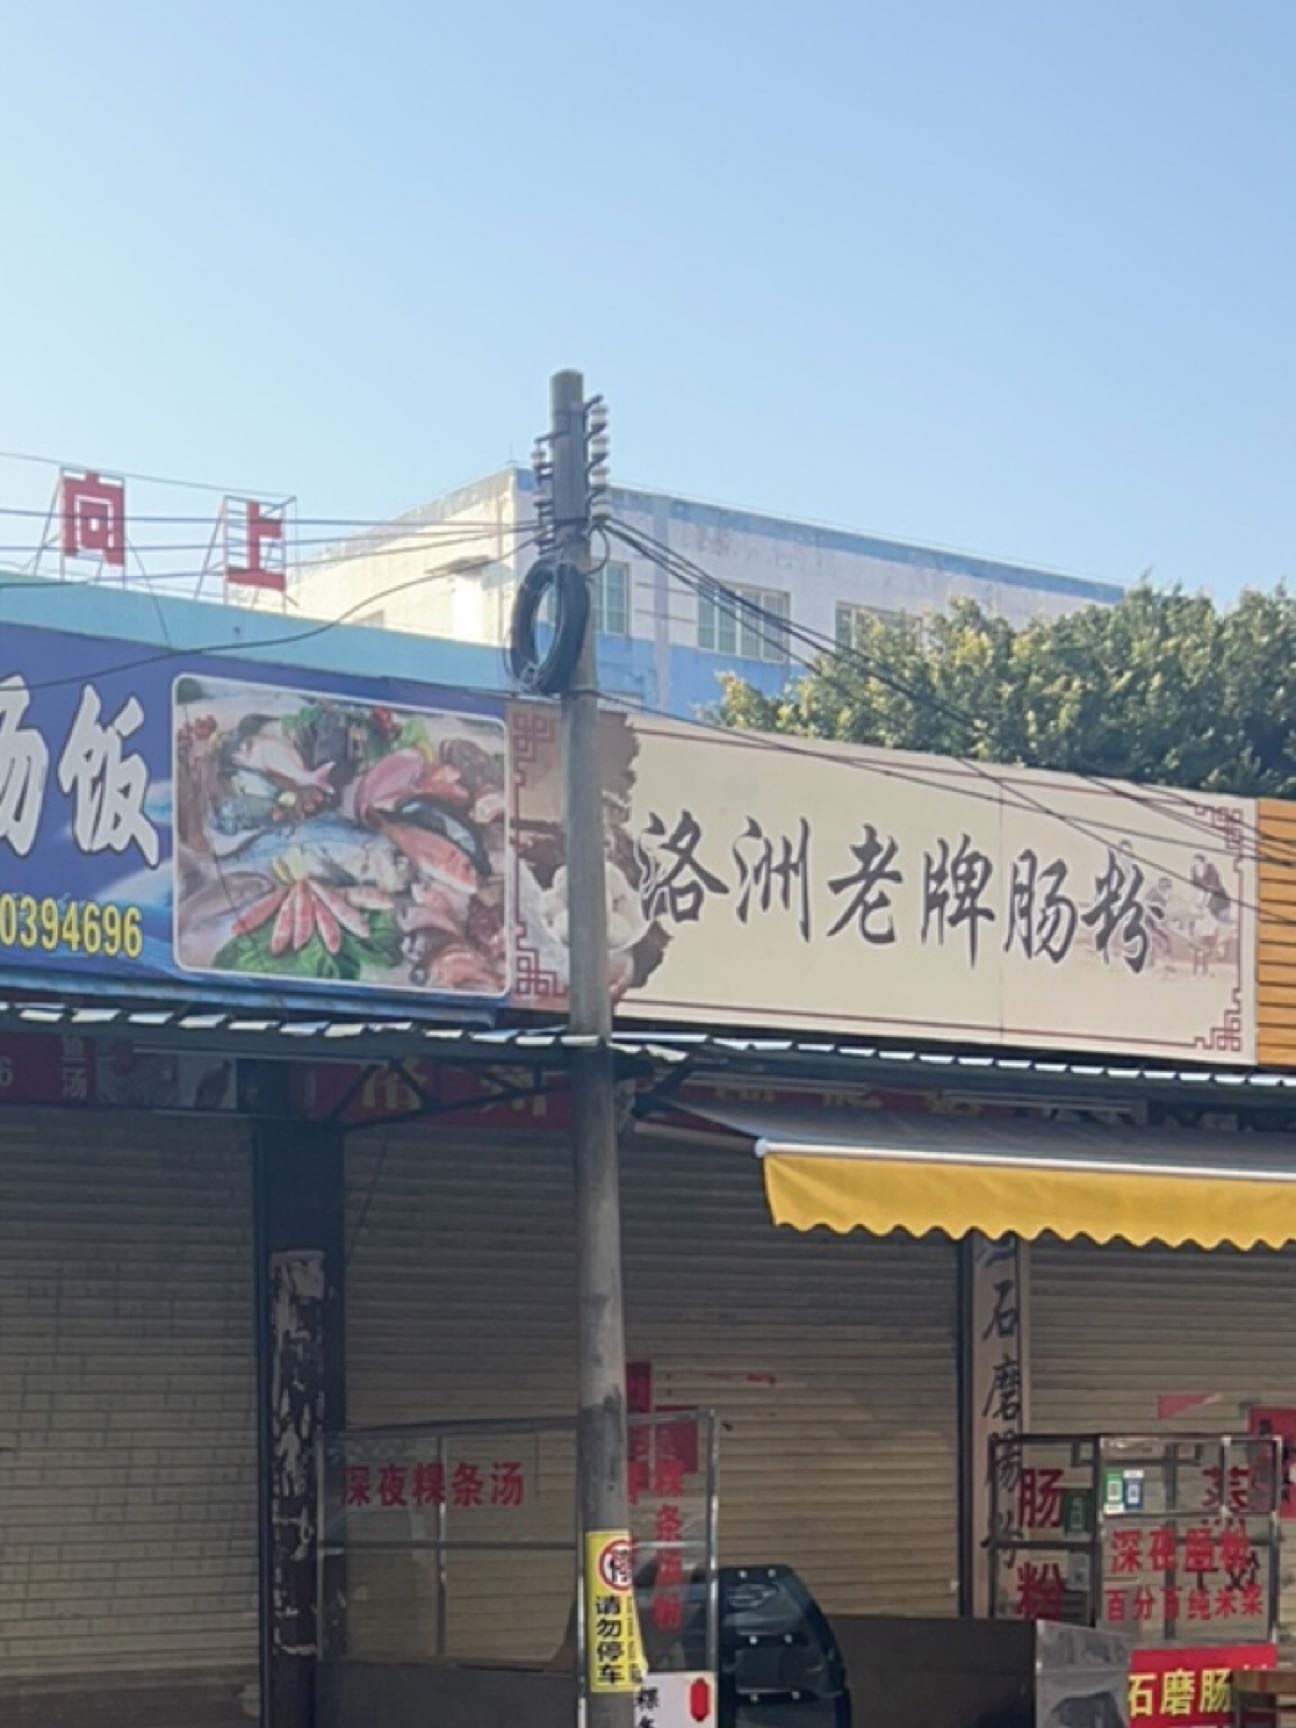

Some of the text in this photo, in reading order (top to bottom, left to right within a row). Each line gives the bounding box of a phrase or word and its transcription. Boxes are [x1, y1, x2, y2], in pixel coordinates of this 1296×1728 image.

[595, 1596, 625, 1685] 请勿停车
[1128, 1664, 1270, 1718] 石磨肠
